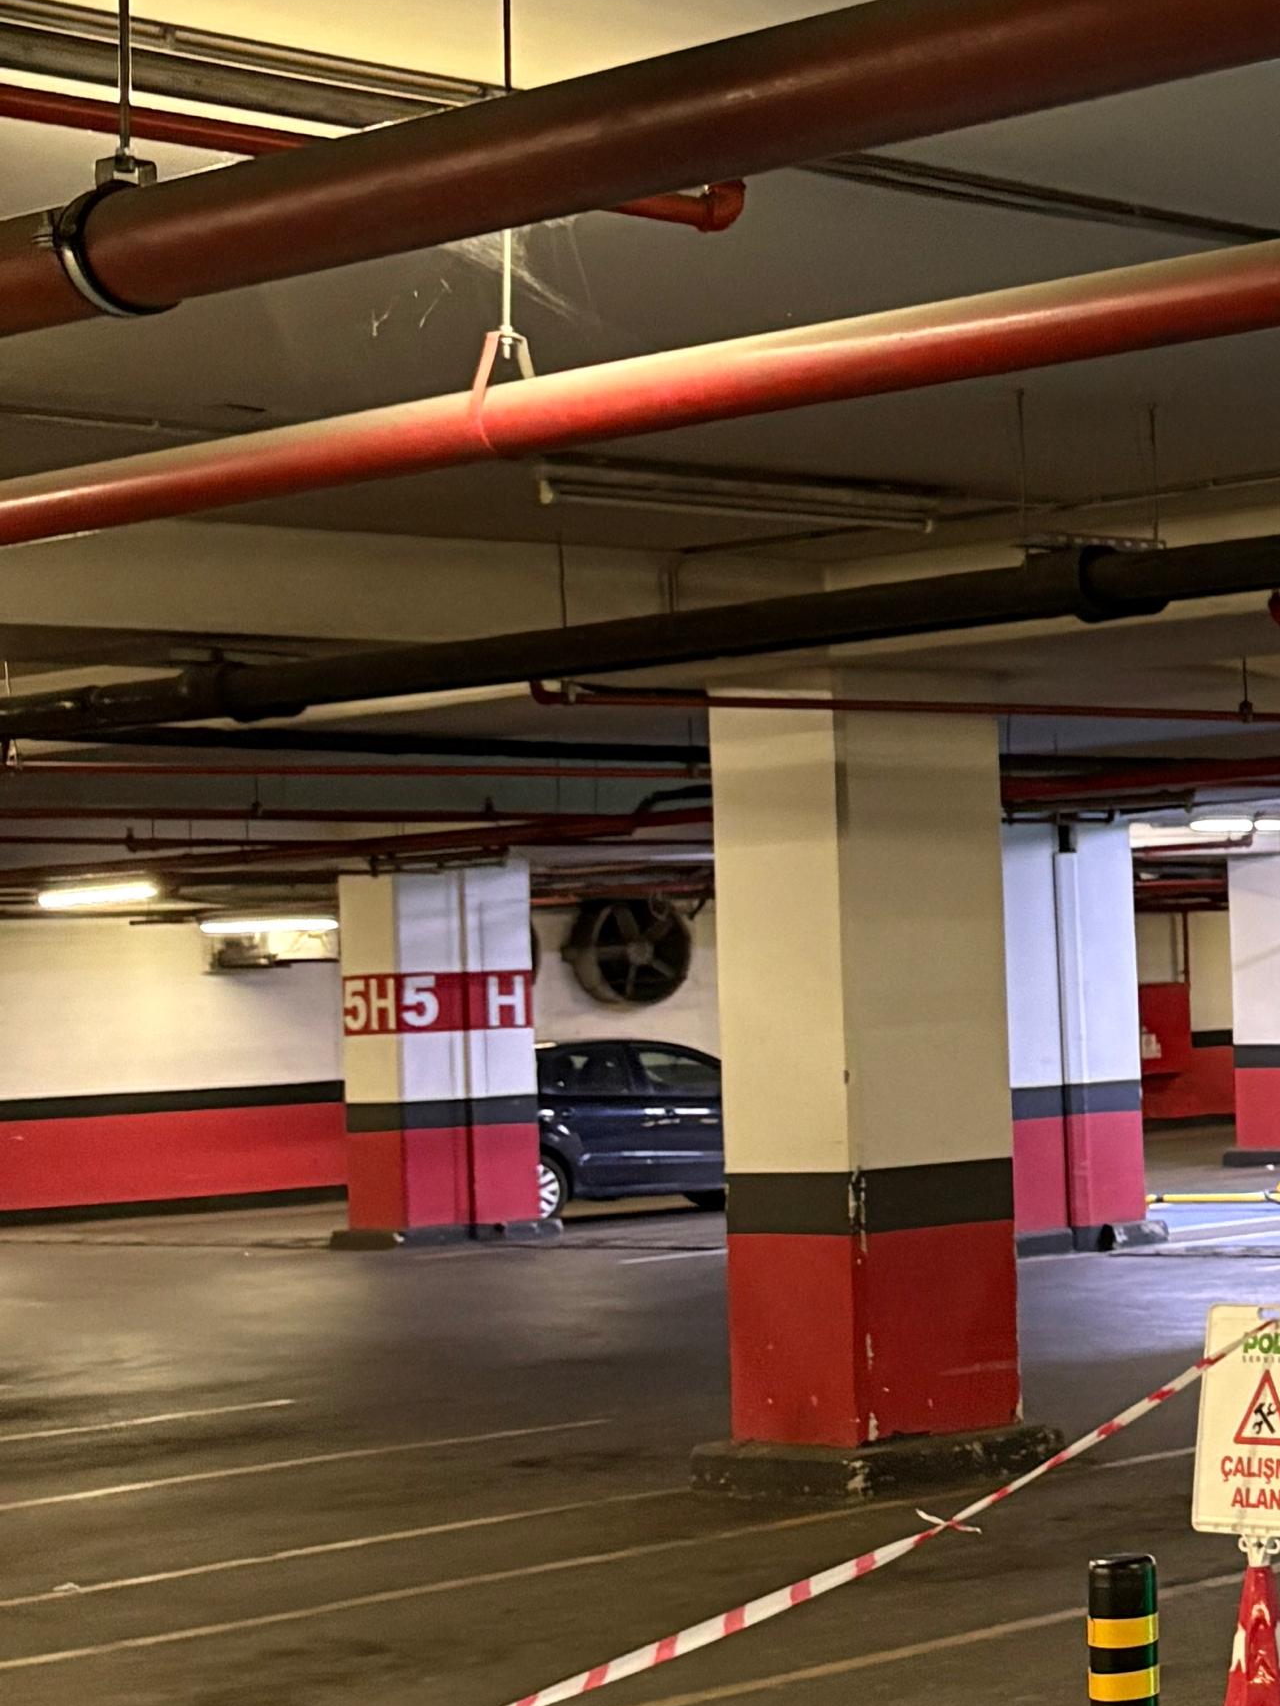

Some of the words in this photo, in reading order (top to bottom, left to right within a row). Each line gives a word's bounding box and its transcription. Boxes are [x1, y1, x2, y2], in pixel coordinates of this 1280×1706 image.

[344, 978, 396, 1030] 5H
[402, 975, 439, 1027] 5
[487, 975, 526, 1026] H
